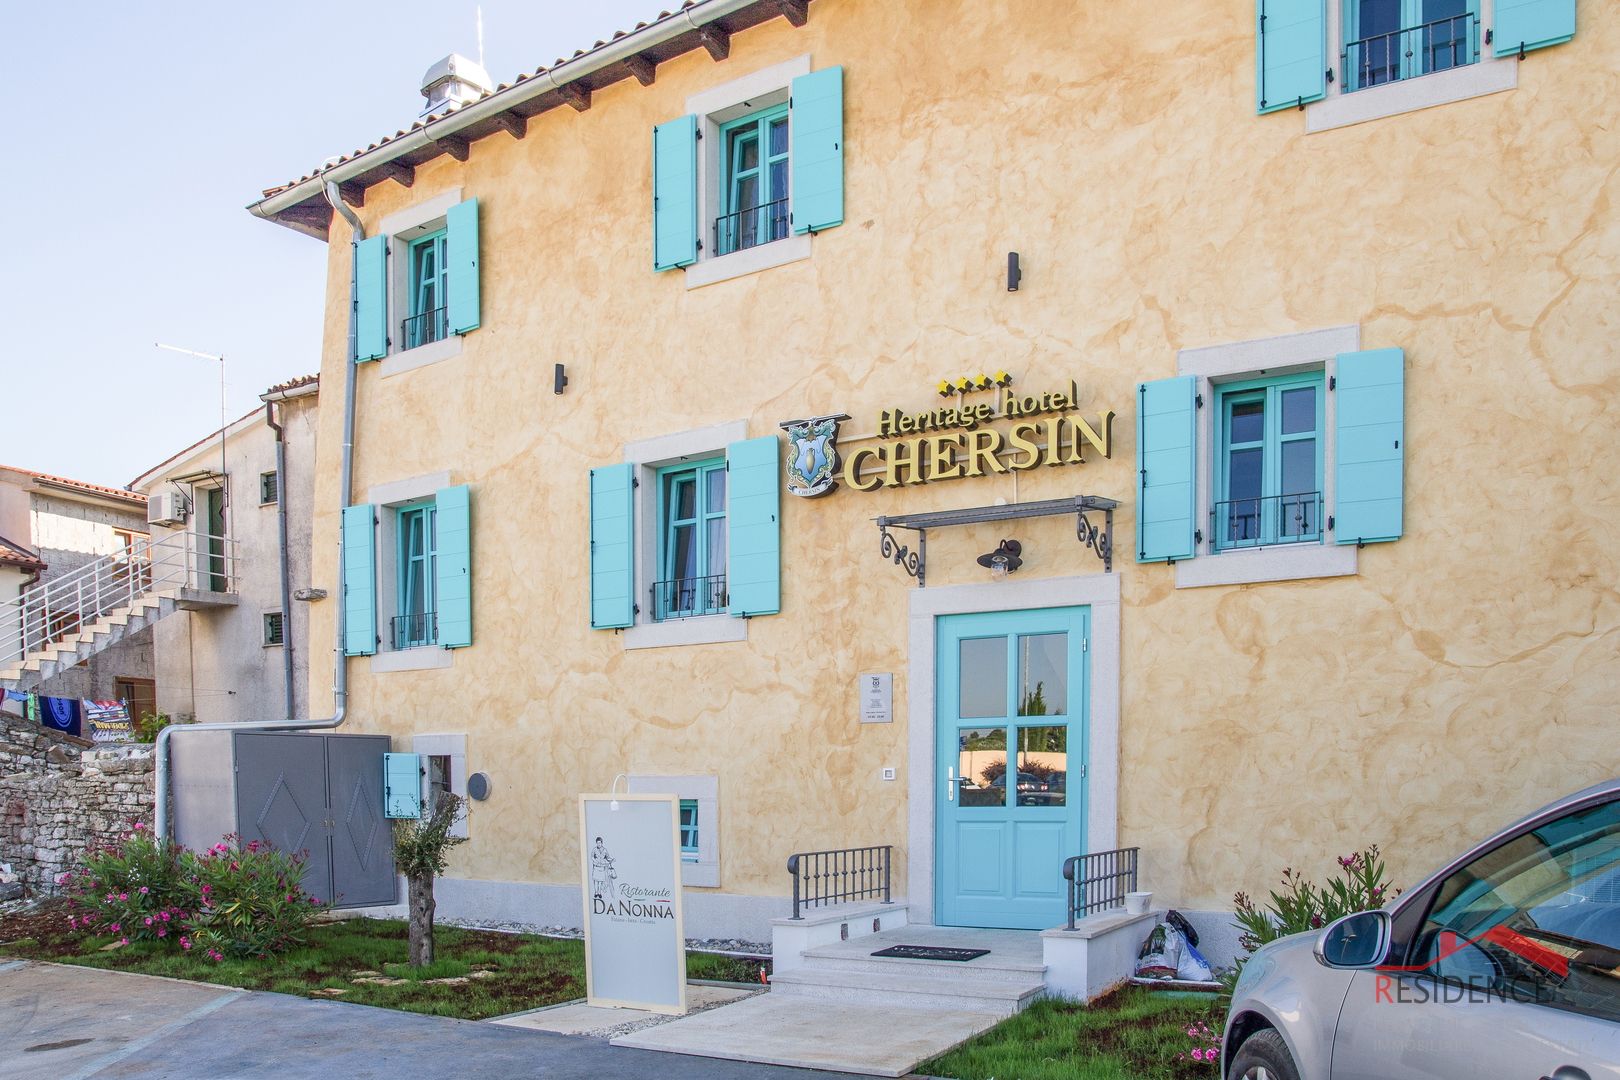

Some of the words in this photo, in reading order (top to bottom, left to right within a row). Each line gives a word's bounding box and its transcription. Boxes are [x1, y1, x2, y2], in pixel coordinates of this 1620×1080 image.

[876, 402, 991, 437] Heritage
[1002, 378, 1076, 416] hotel
[844, 409, 1114, 491] CHERSIN
[619, 883, 671, 898] Ristorante
